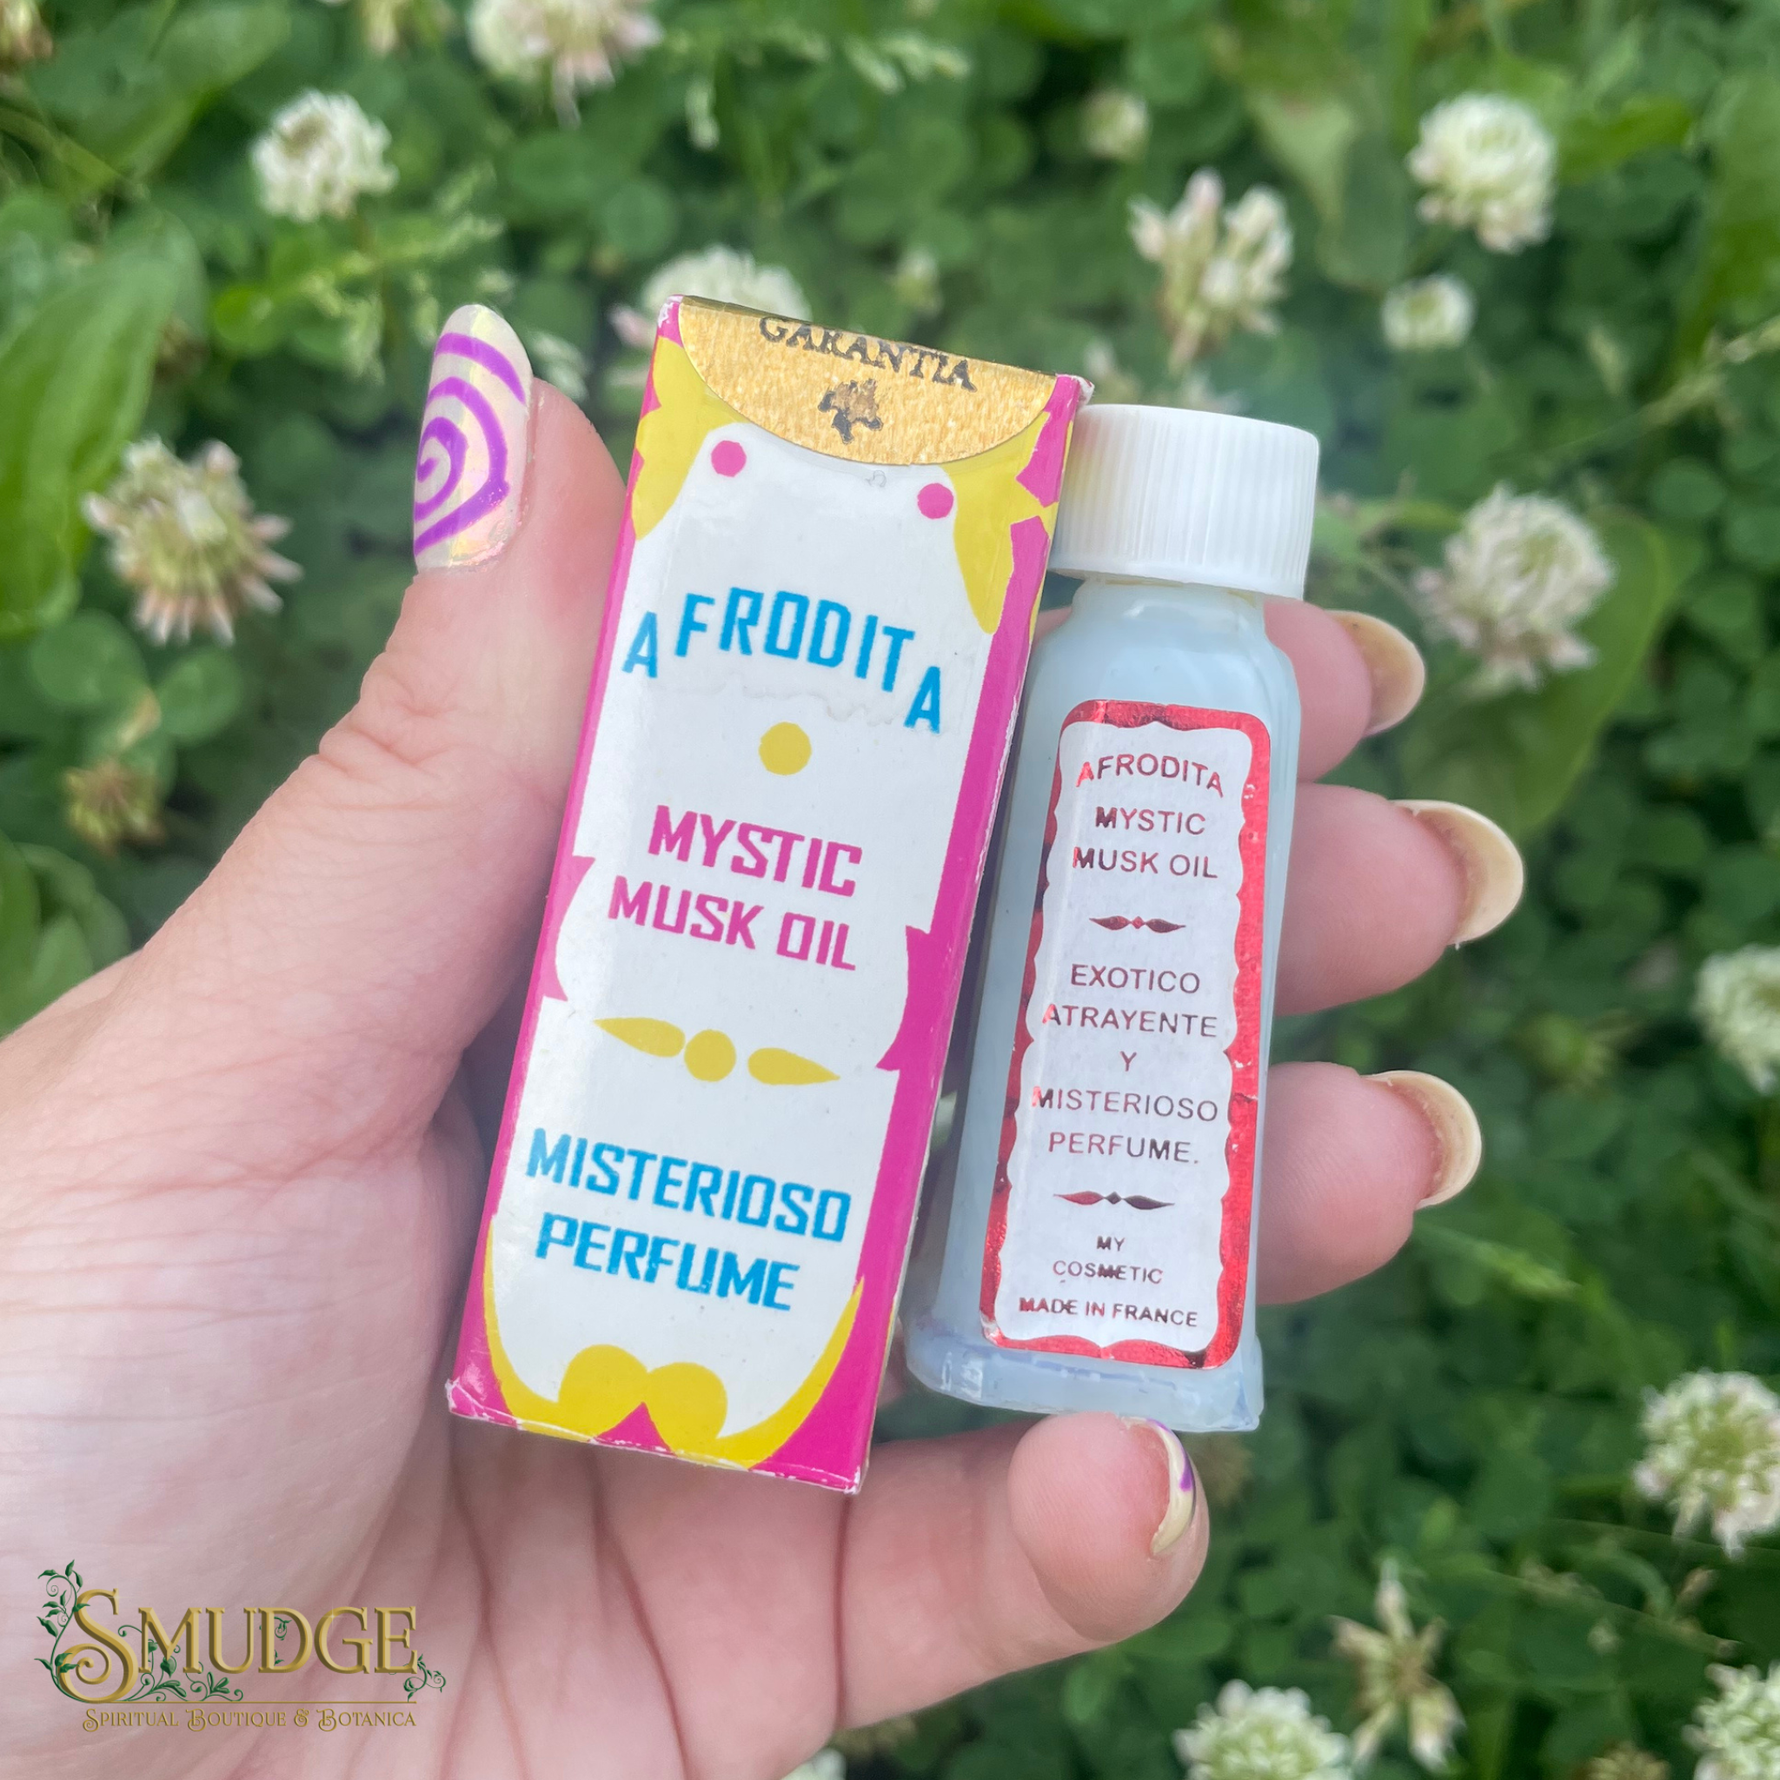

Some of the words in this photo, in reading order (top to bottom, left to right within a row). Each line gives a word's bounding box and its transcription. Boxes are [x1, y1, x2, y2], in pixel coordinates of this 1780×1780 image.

[622, 587, 941, 734] AFRODITA
[1076, 754, 1223, 798] AFRODITA
[1095, 806, 1206, 835] MYSTIC
[648, 805, 862, 897] MYSTIC
[1073, 847, 1159, 874] MUSK
[1169, 854, 1218, 878] OIL
[608, 876, 764, 950] MUSK
[776, 912, 855, 971] OIL
[1071, 963, 1200, 994] EXOTICO
[1042, 1003, 1217, 1038] ATRAYENTE
[1120, 1051, 1137, 1072] Y
[1031, 1086, 1218, 1121] MISTERIOSO
[1048, 1132, 1199, 1164] PERFUME.
[526, 1128, 852, 1242] MISTERIOSO
[1096, 1236, 1125, 1251] MY
[535, 1212, 800, 1311] PERFUME
[1053, 1260, 1163, 1284] COSMETIC
[1019, 1297, 1078, 1315] MADE
[1085, 1302, 1105, 1317] IN
[1112, 1303, 1198, 1327] FRANCE
